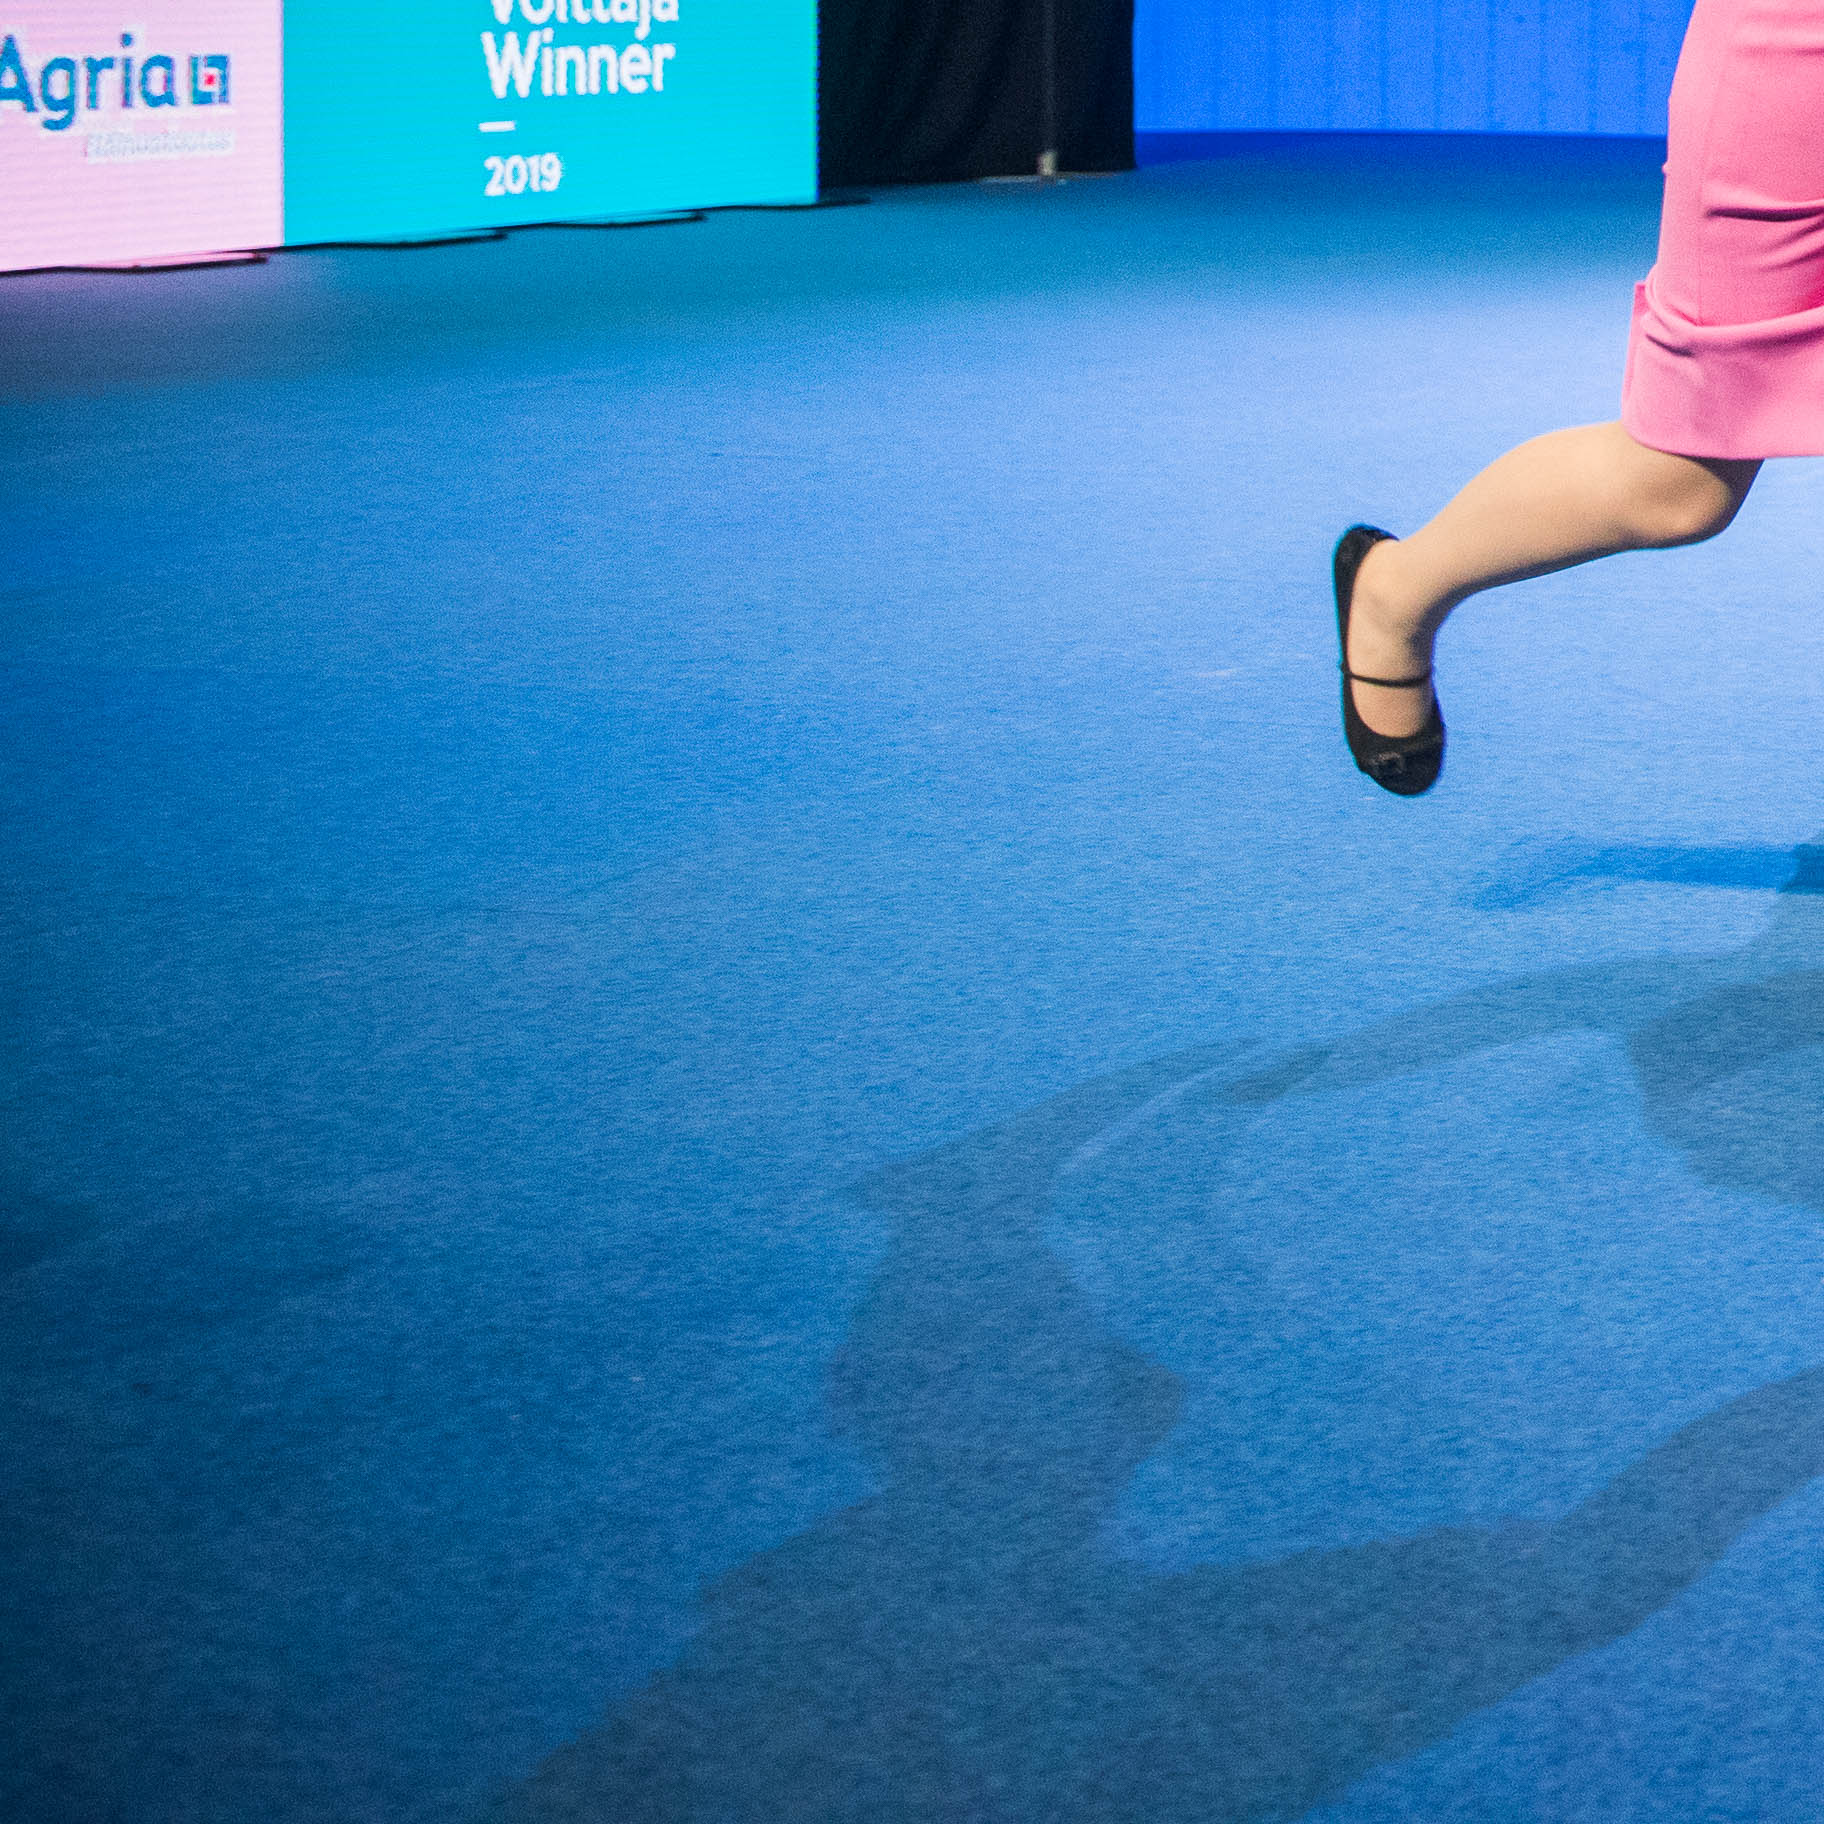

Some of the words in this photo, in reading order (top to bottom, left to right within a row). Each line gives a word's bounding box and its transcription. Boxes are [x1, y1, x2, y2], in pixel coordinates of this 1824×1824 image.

[0, 33, 178, 131] Agria
[480, 27, 676, 100] Winner
[483, 152, 563, 197] 2019
